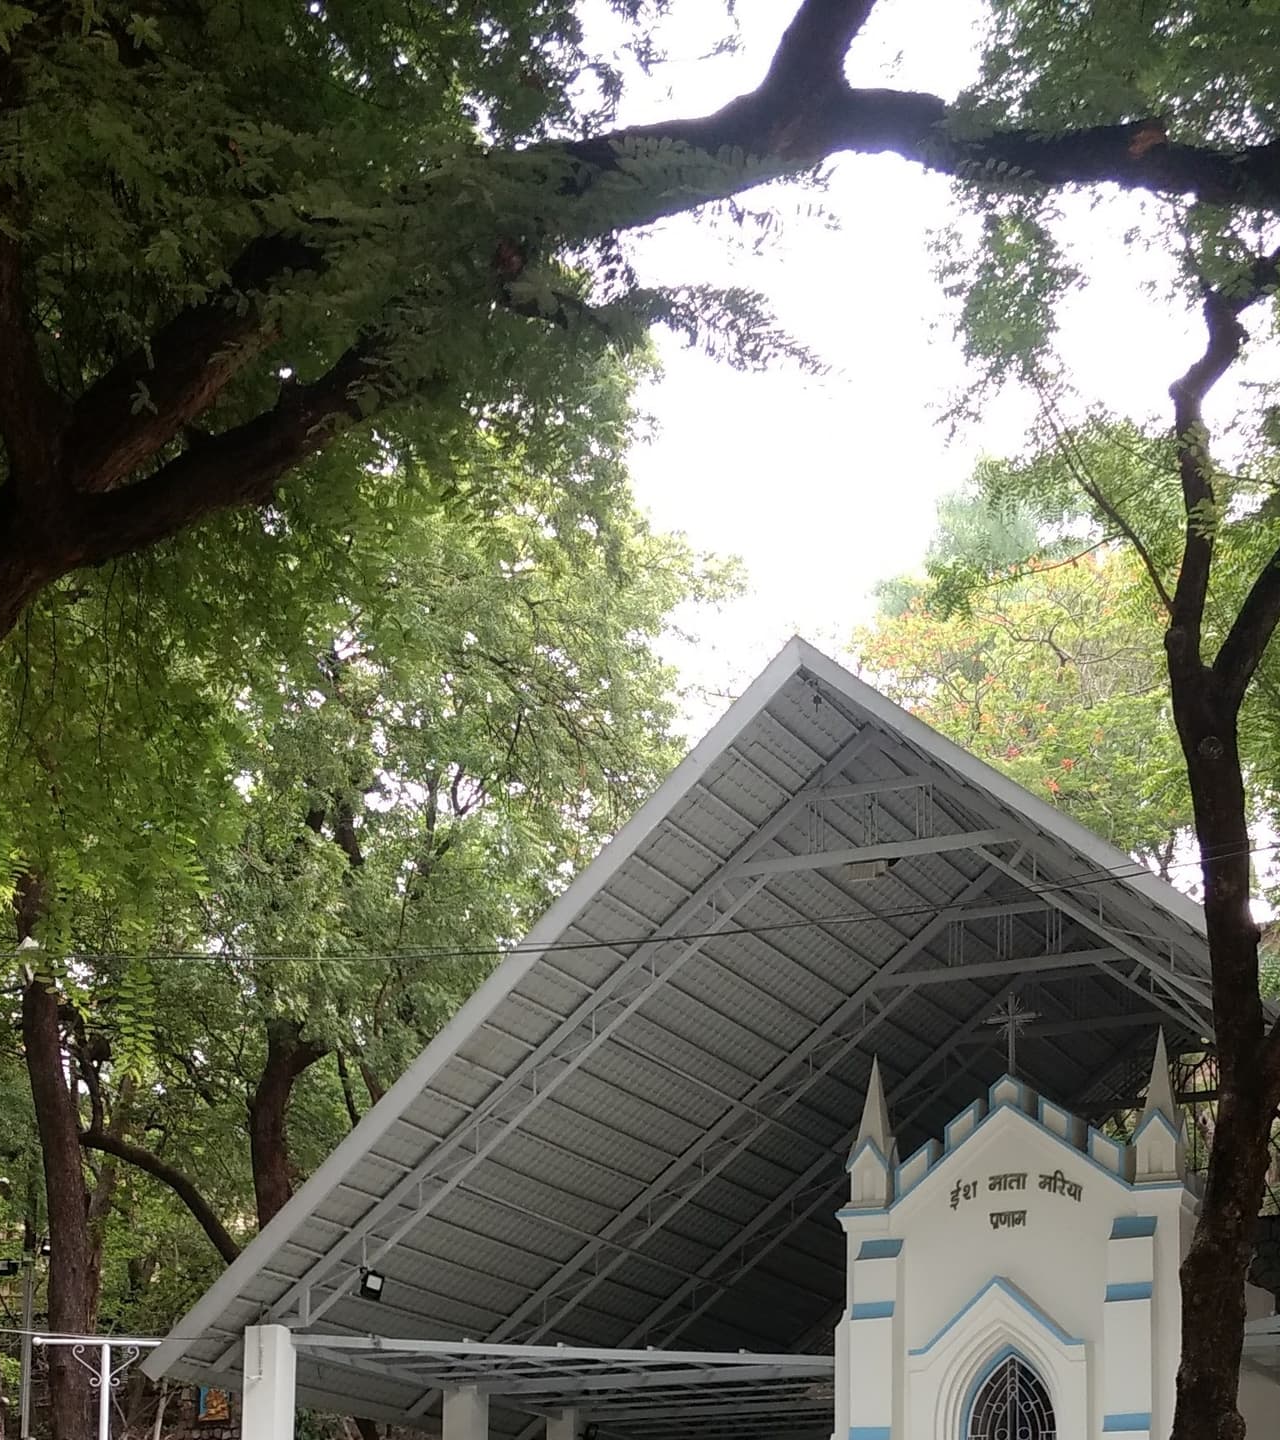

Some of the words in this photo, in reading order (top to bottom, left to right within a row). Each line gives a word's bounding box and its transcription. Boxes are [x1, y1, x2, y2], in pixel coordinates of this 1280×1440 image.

[950, 1178, 978, 1211] ईश
[988, 1172, 1028, 1191] माता
[1038, 1169, 1083, 1203] मरिया
[989, 1209, 1027, 1230] प्रणाम
